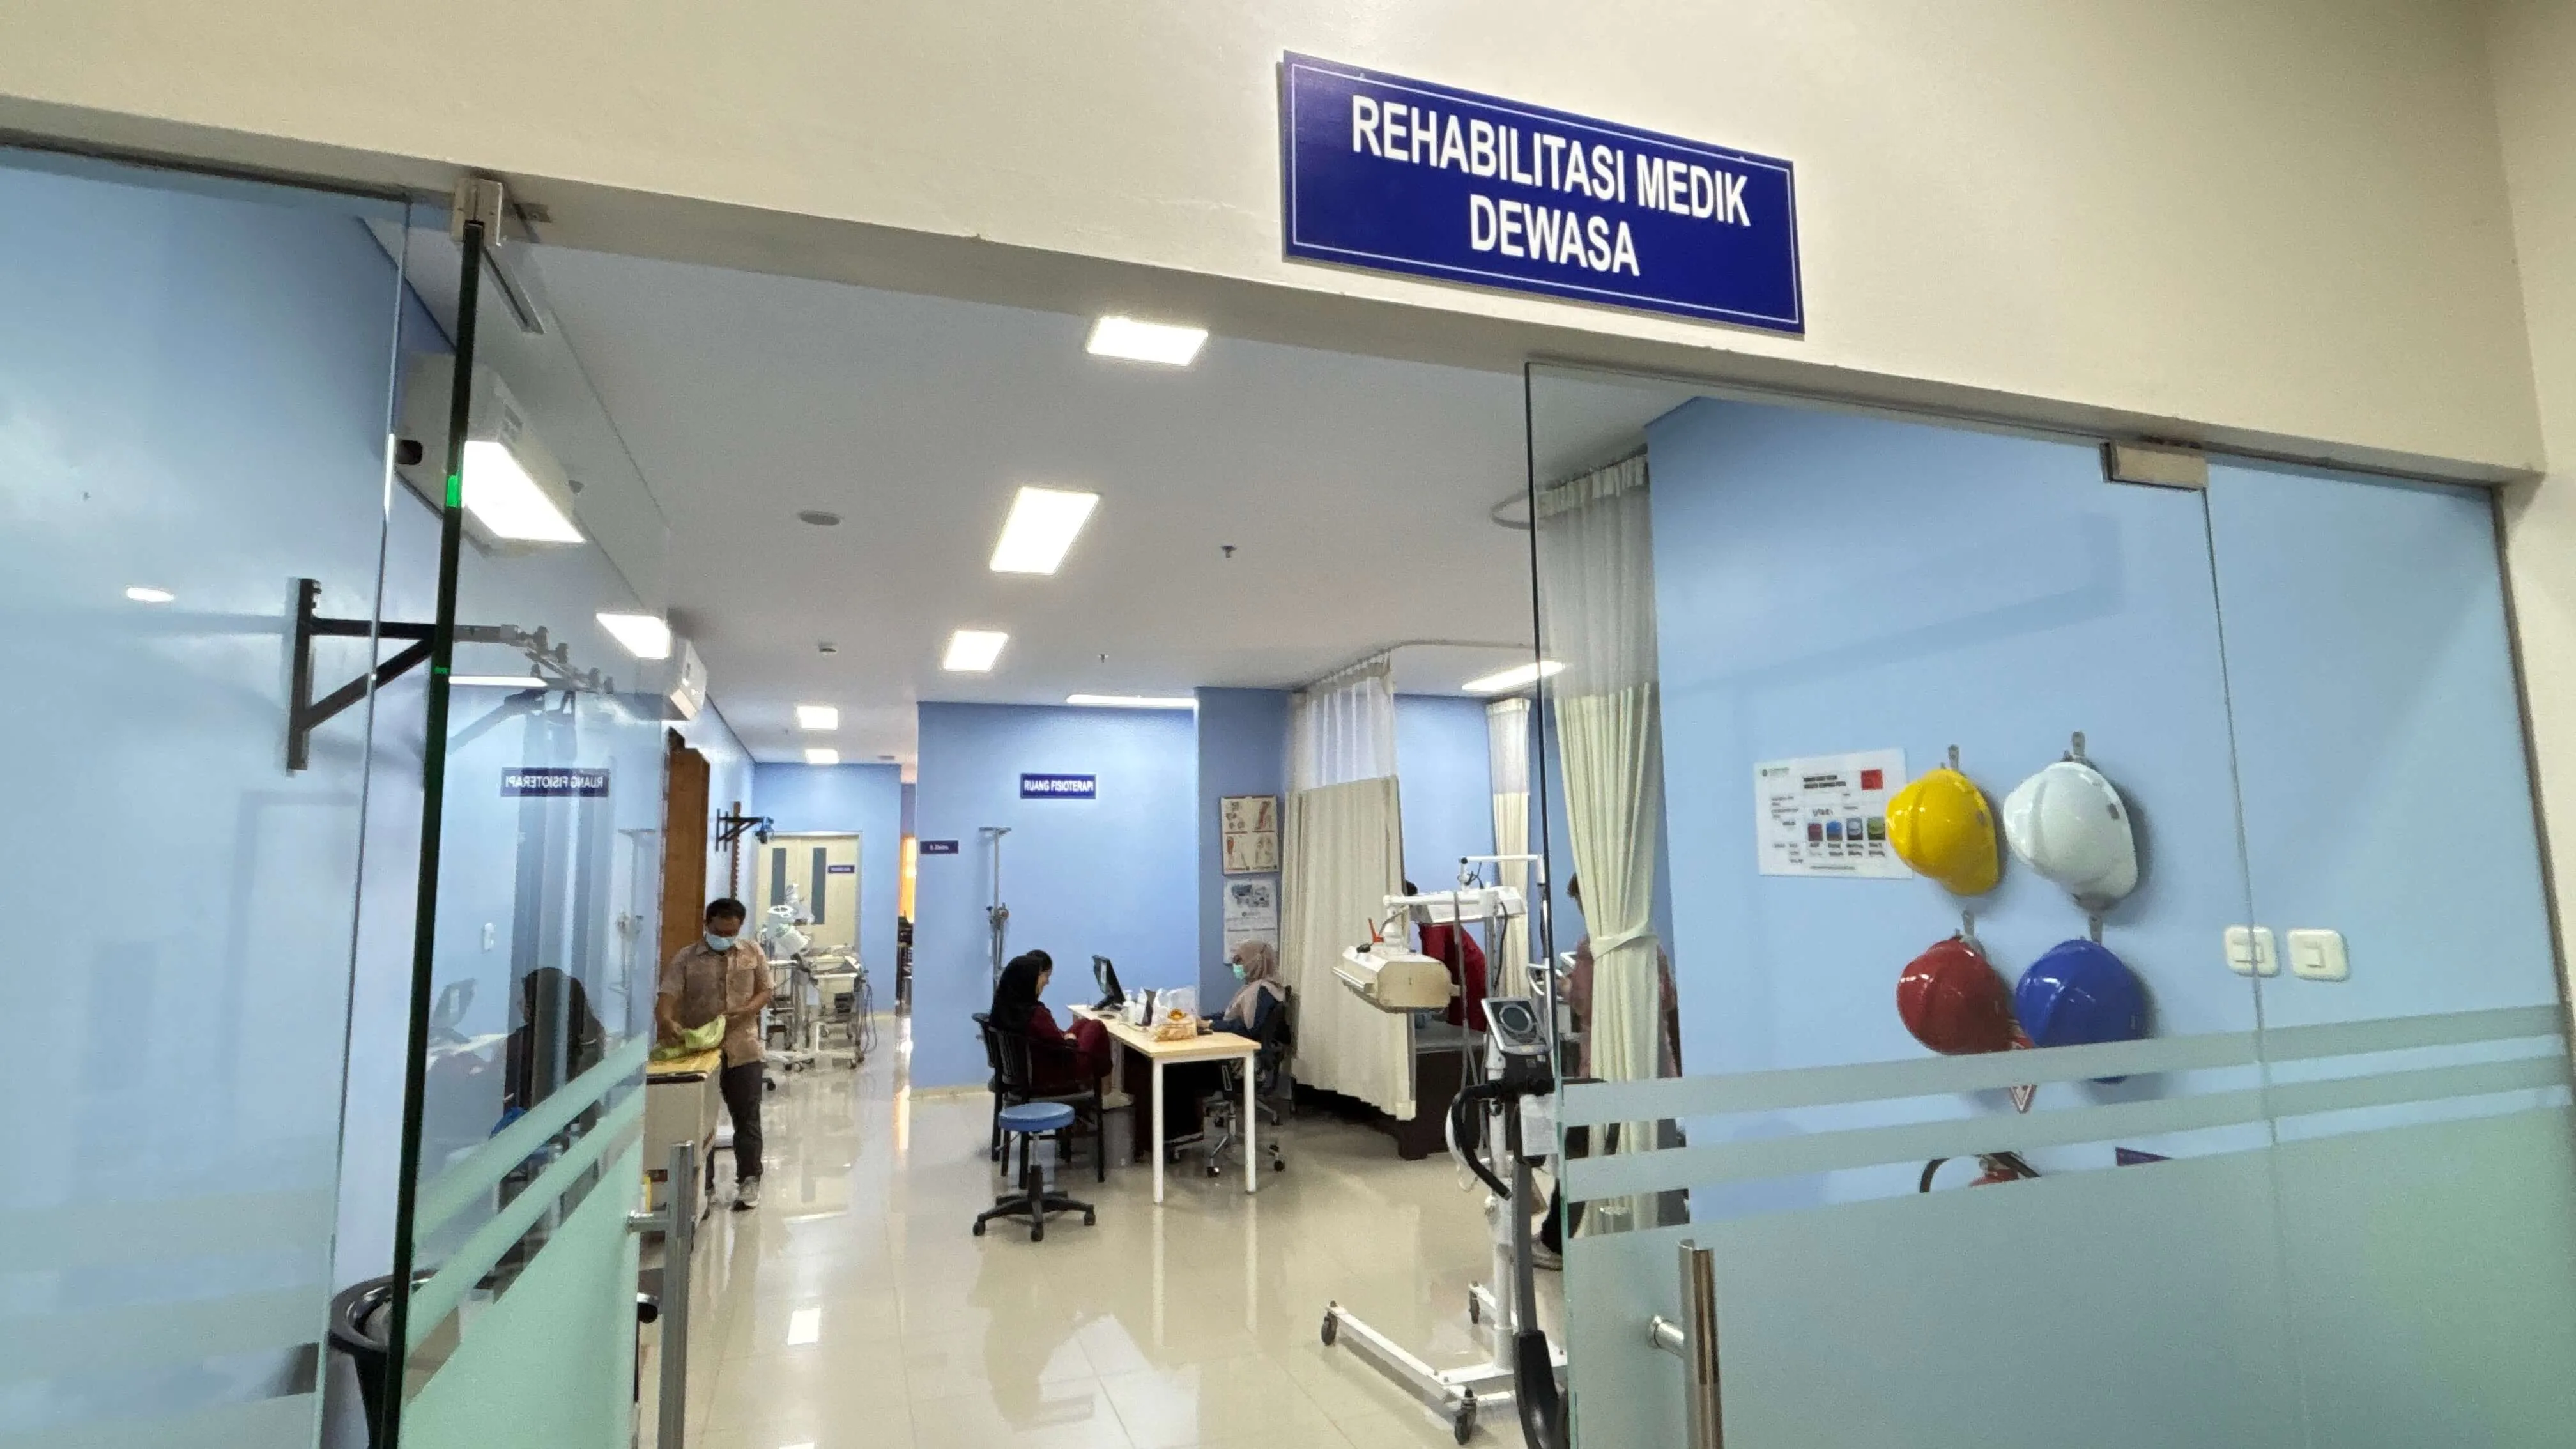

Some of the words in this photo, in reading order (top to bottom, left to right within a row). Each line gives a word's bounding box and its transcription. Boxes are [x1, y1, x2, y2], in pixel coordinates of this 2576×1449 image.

[1351, 94, 1626, 204] REHABILITASI
[1637, 153, 1752, 227] MEDIK
[1469, 194, 1640, 277] DEWASA
[1023, 779, 1050, 792] RUANG
[1050, 779, 1094, 792] FISIOTERAPI
